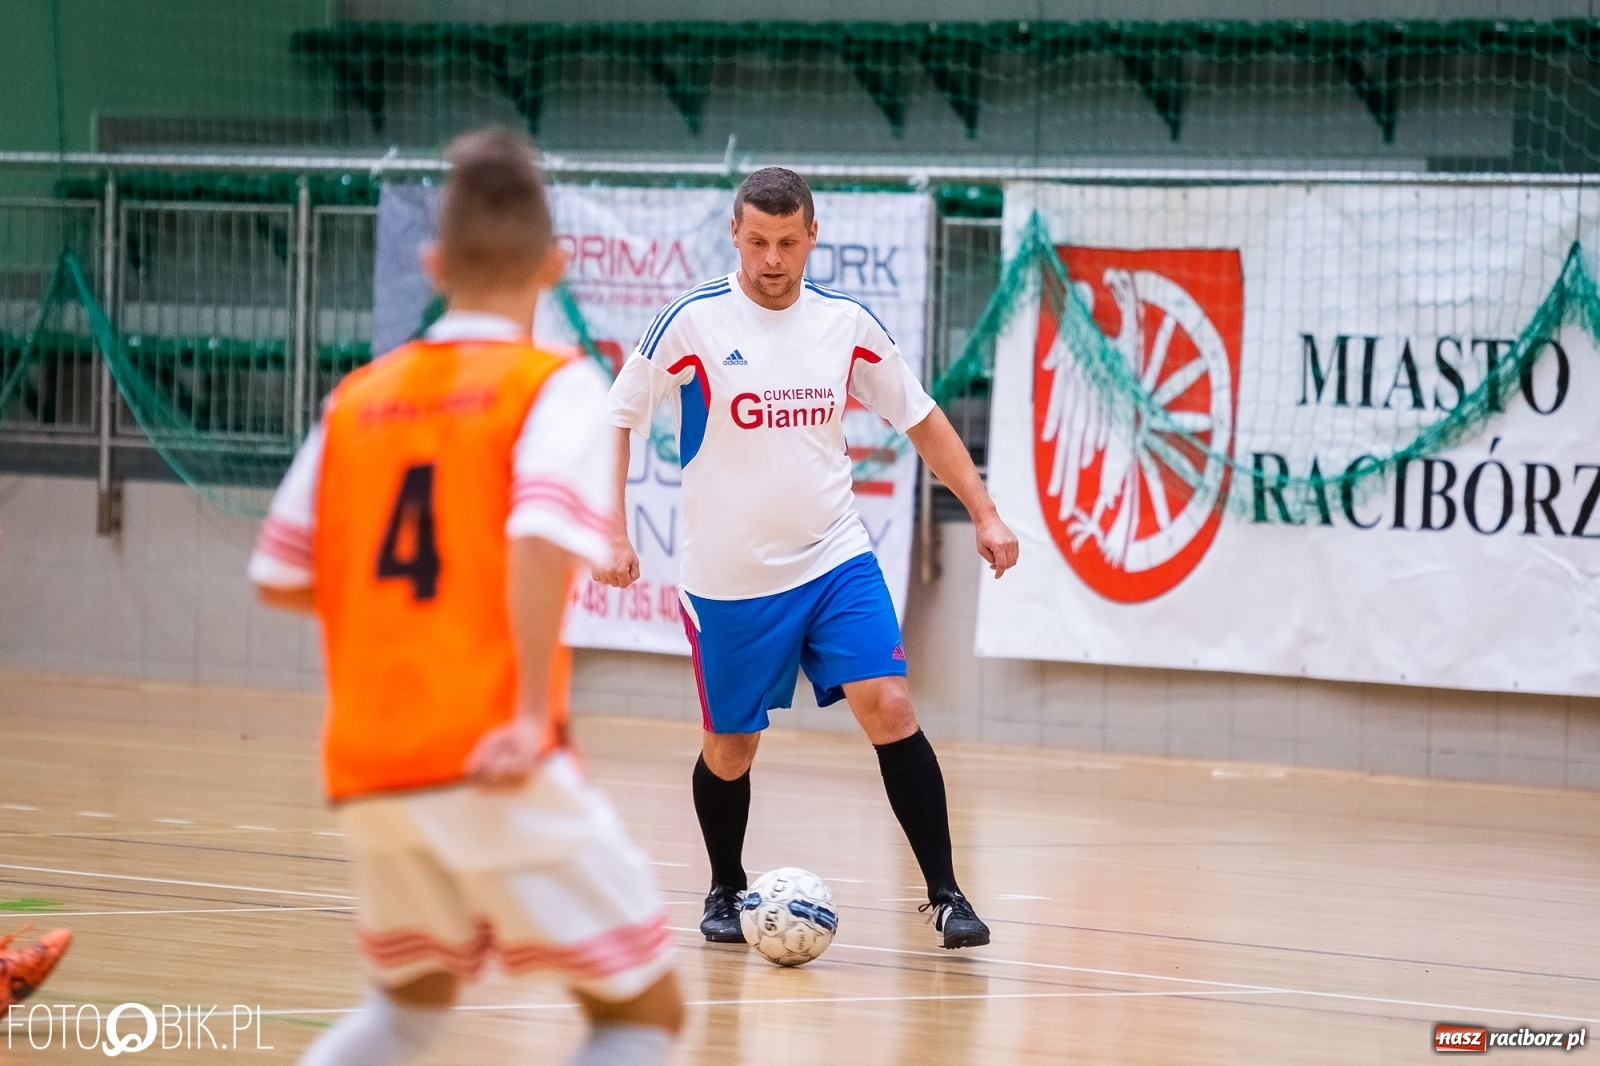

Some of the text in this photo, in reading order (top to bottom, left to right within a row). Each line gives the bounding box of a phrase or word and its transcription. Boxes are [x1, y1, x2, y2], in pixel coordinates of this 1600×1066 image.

[806, 243, 897, 286] ORK
[763, 388, 835, 401] CUKIERNIA
[1298, 333, 1569, 415] MIASTO
[730, 392, 835, 430] Gianni
[1251, 436, 1600, 538] RACIBÓRZ
[377, 463, 441, 600] 4
